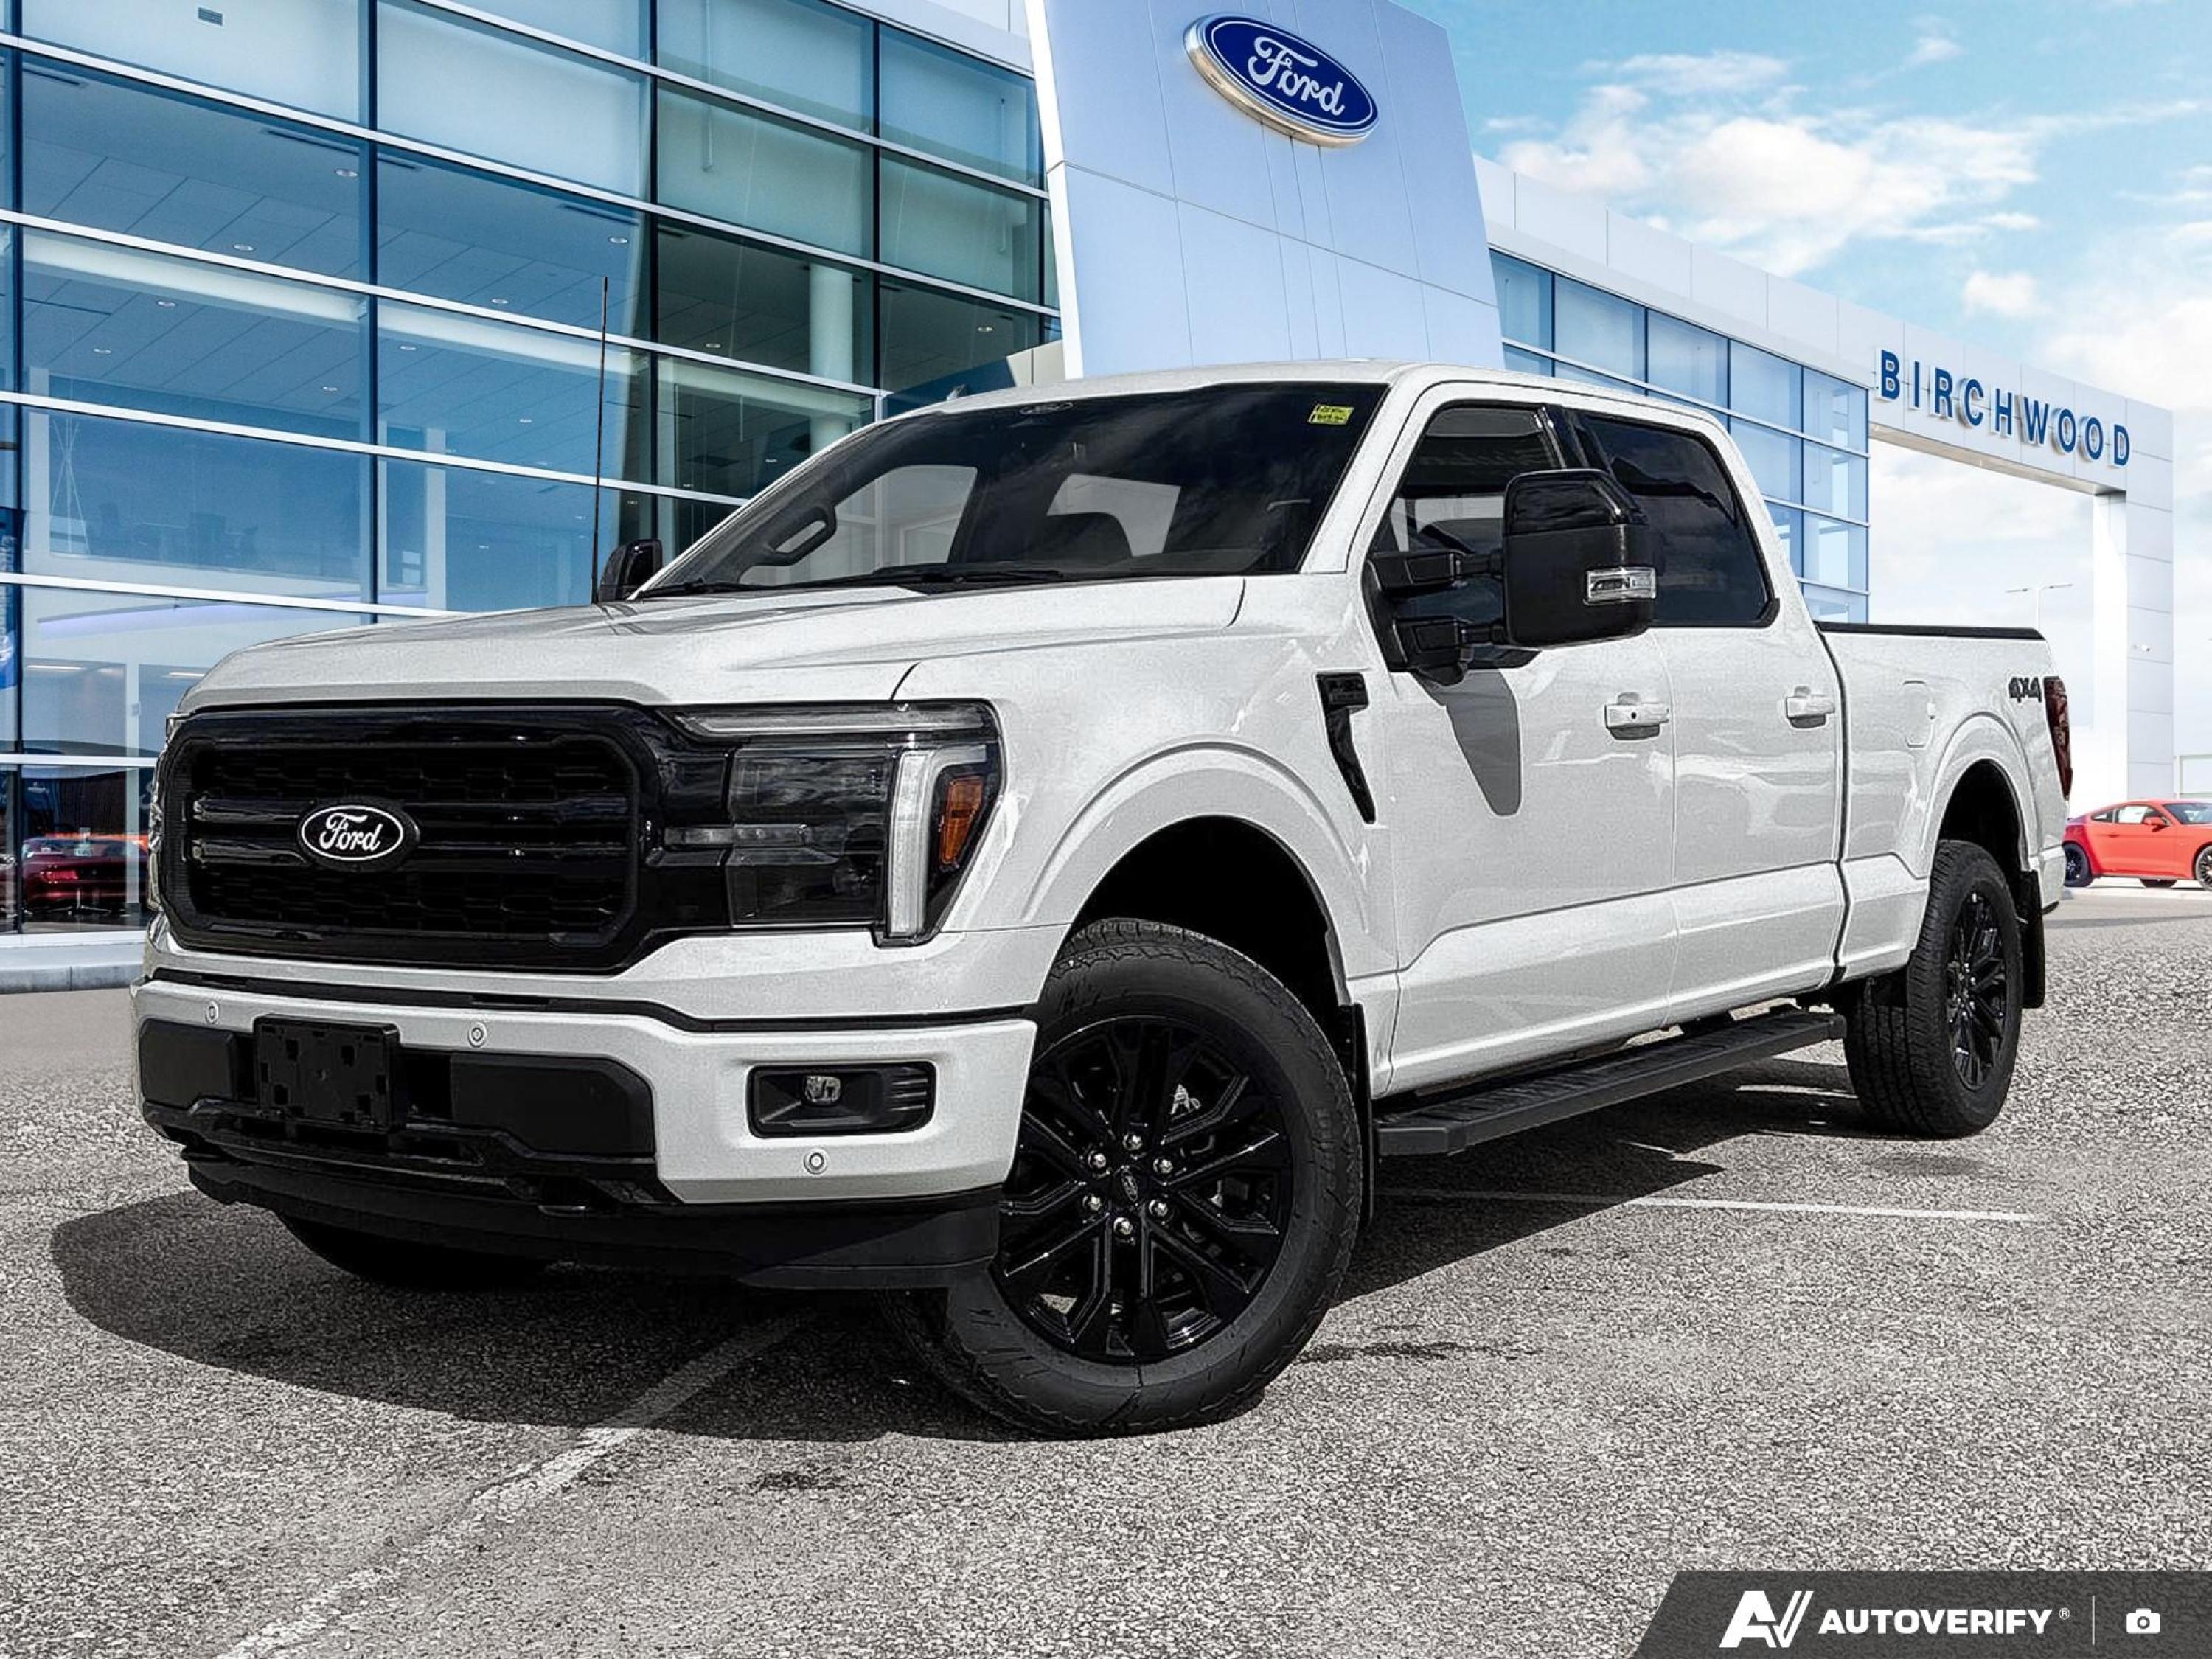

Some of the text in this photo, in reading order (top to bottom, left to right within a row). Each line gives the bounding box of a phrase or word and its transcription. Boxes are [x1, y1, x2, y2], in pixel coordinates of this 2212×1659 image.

[1248, 36, 1345, 116] Ford
[1881, 349, 2130, 467] BIRCHWOOD
[319, 813, 383, 852] Ford
